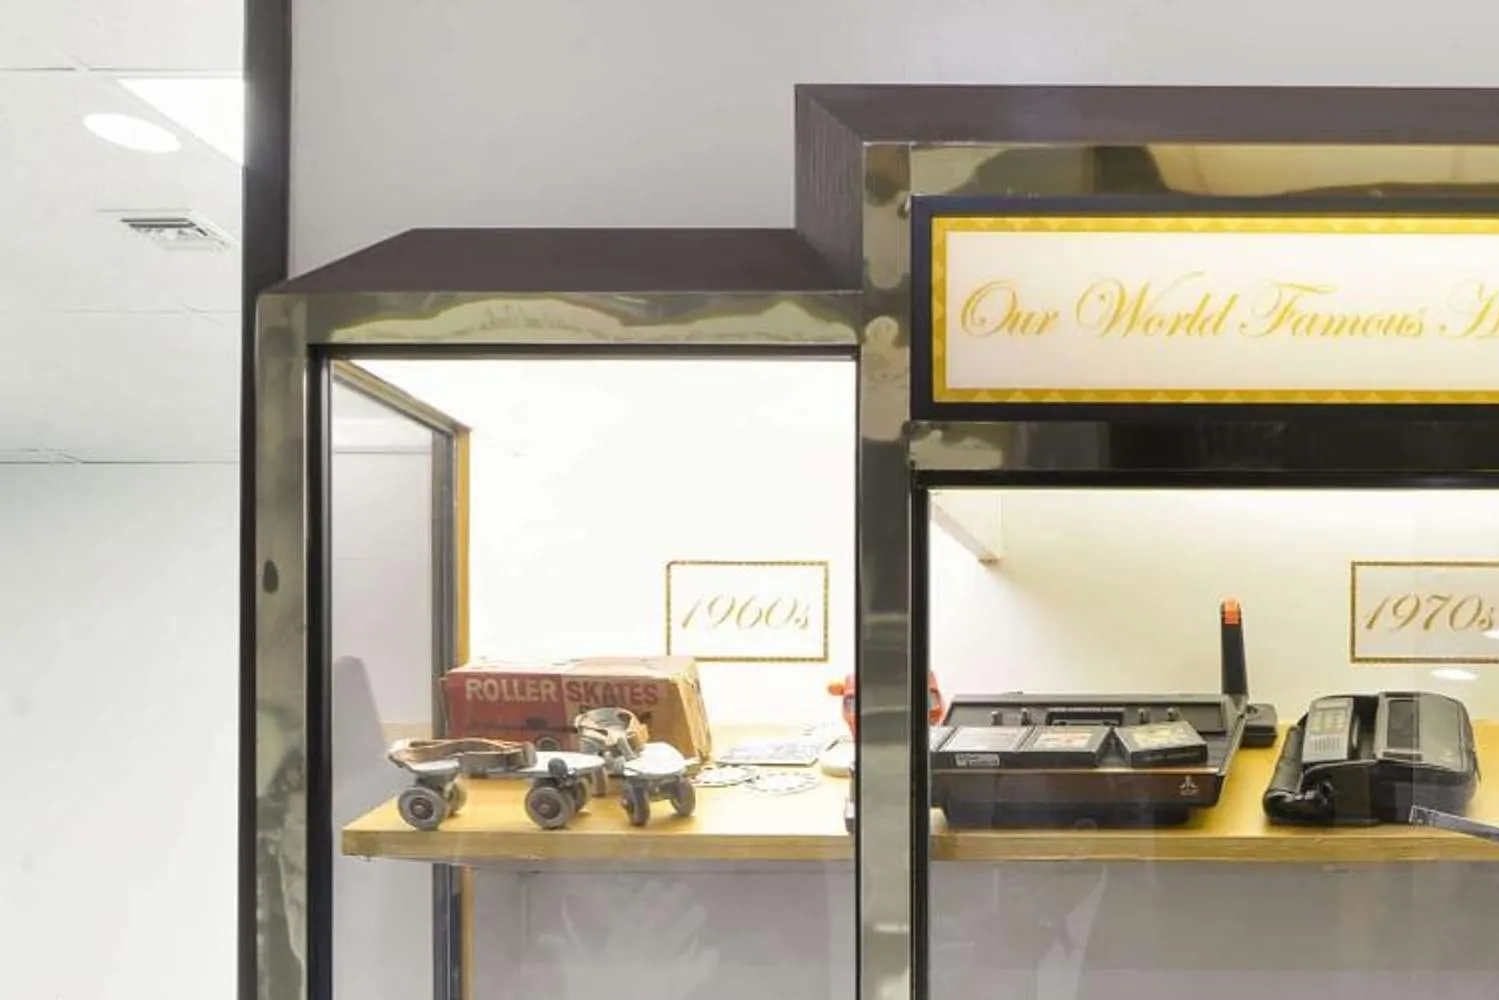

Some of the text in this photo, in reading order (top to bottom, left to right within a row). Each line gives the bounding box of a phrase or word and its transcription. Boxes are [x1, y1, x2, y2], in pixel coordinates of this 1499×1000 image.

[959, 279, 1058, 338] Our
[1075, 272, 1240, 339] World
[1239, 281, 1426, 338] Famous
[681, 594, 811, 630] 1960s
[1364, 593, 1496, 632] 1970s
[465, 678, 659, 705] ROLLER SKATES
